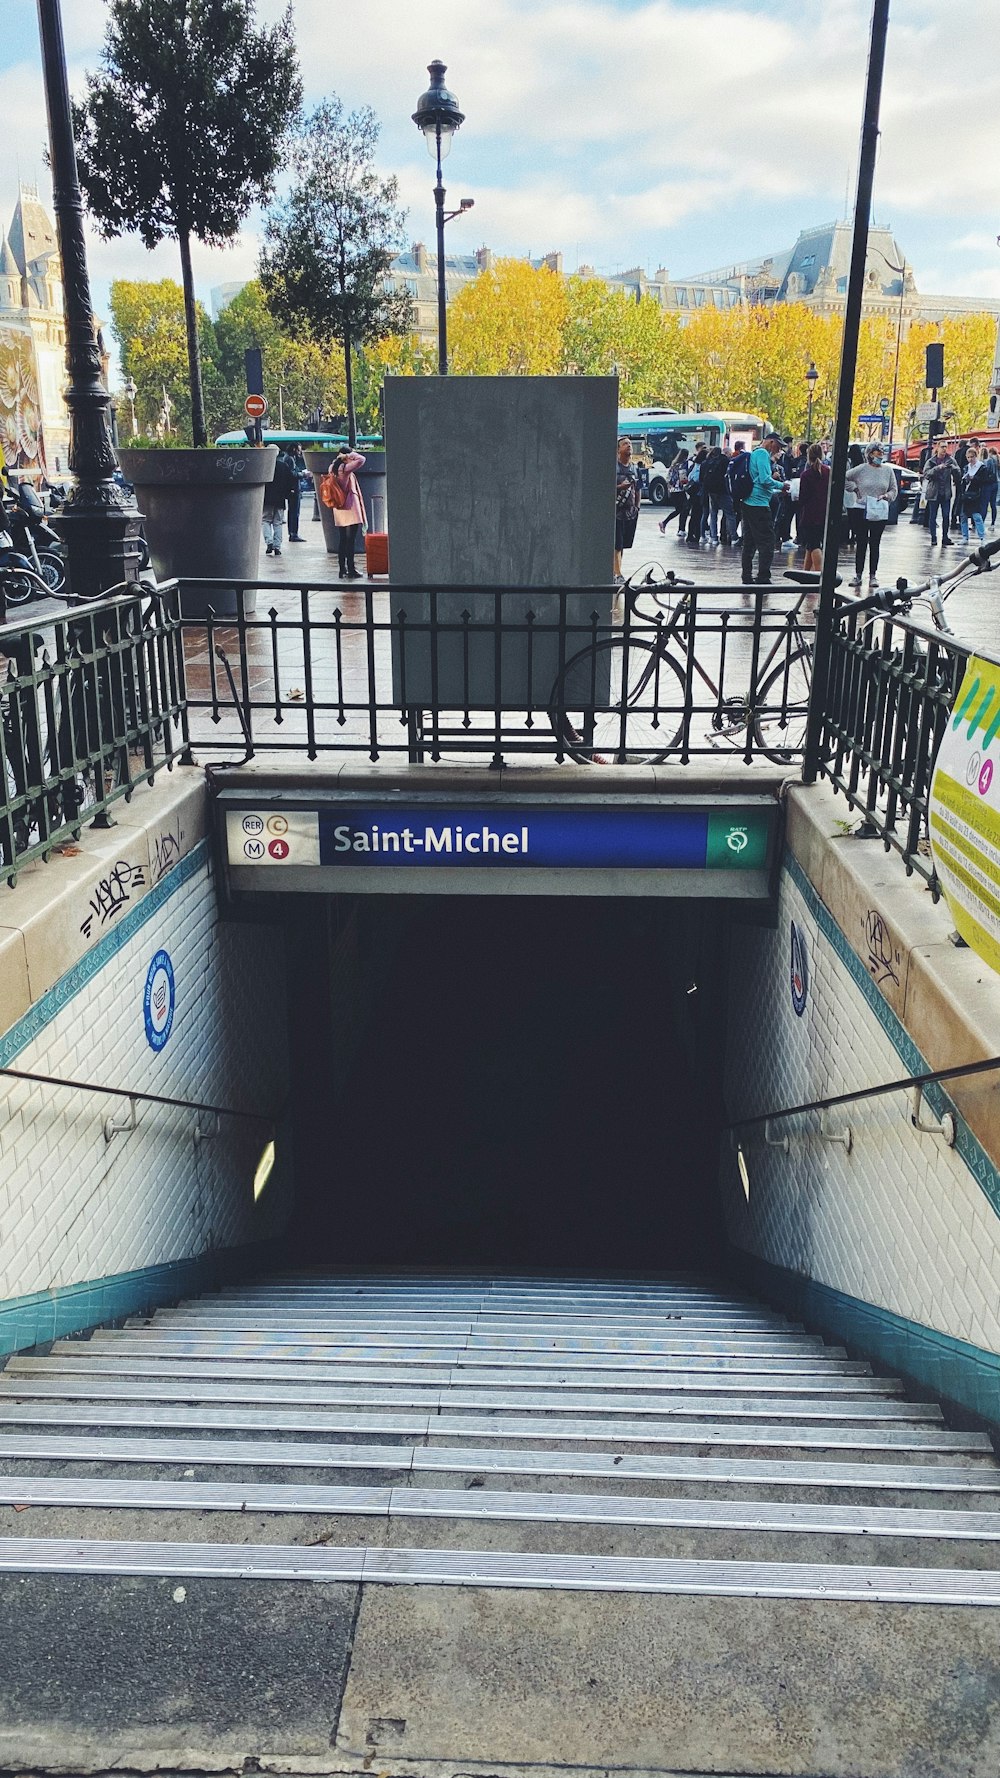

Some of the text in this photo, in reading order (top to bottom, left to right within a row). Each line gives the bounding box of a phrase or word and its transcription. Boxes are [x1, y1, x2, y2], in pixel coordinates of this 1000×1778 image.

[981, 766, 991, 789] 4
[245, 821, 282, 831] RER C
[333, 825, 529, 853] Saint-Michel
[248, 842, 283, 856] M 4
